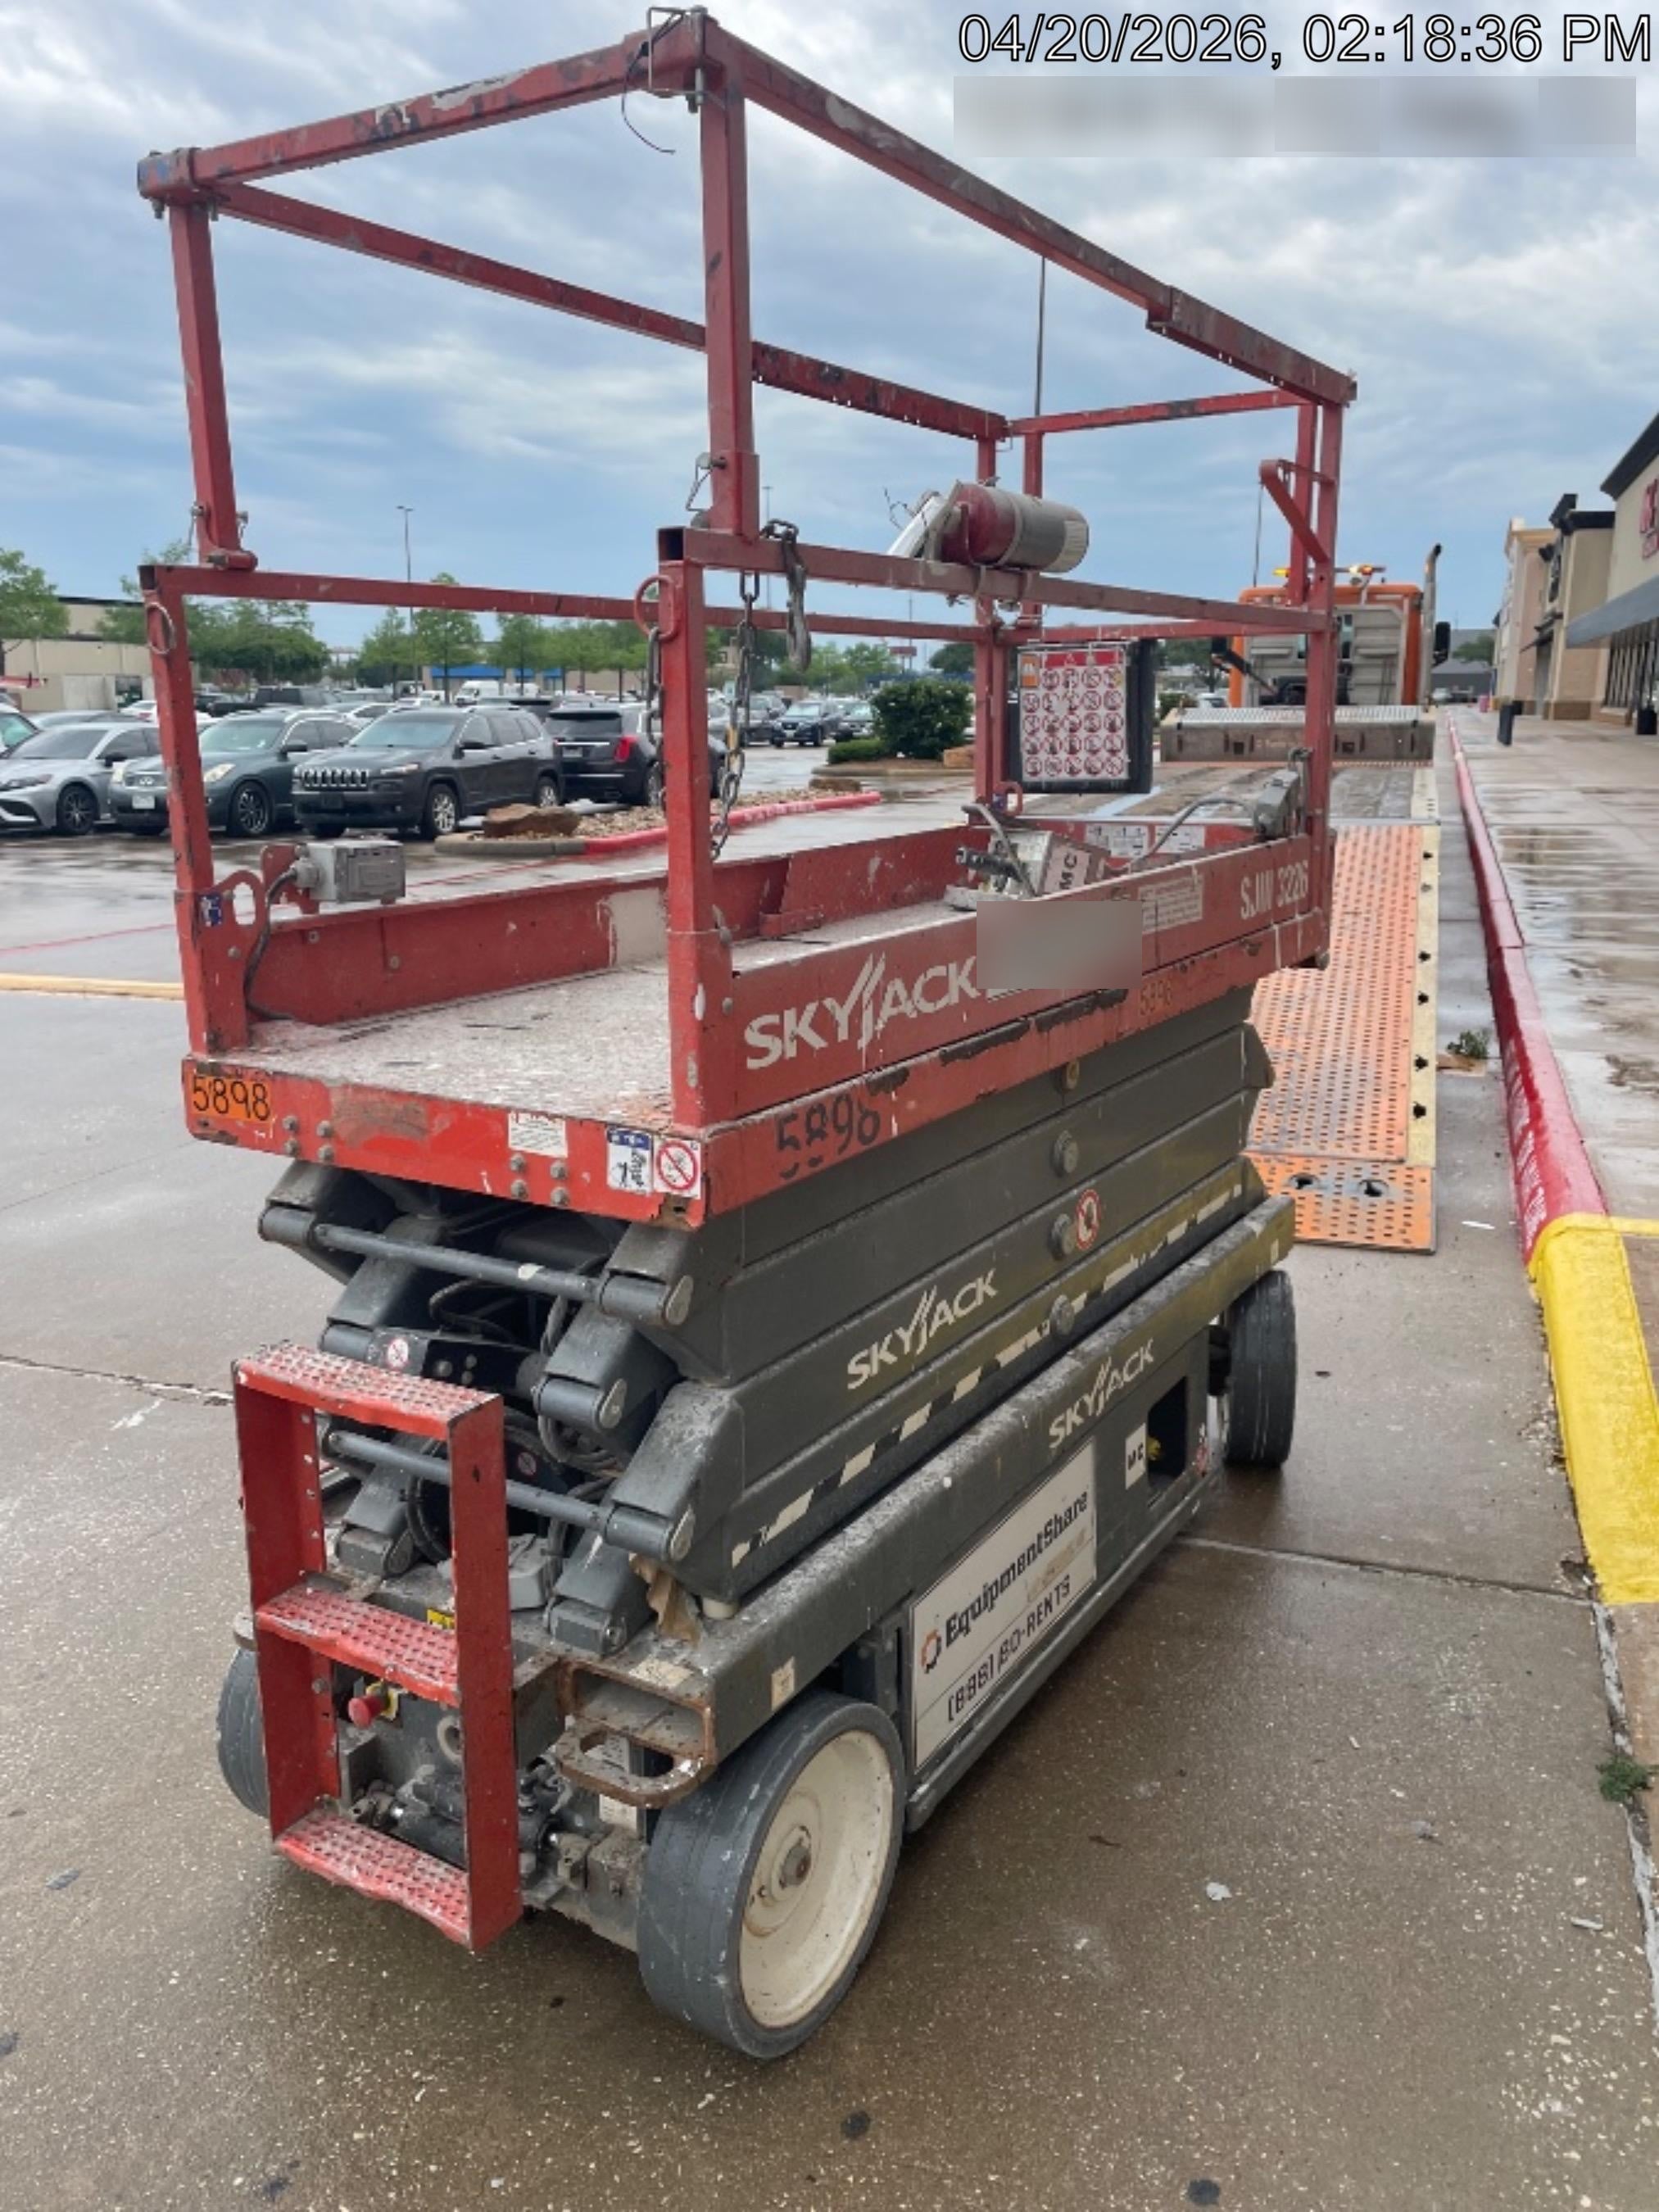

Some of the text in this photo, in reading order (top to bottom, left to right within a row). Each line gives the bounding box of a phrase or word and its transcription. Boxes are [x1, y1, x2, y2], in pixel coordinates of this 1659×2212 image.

[744, 952, 981, 1070] SKYJACK
[193, 1074, 271, 1122] 5898
[847, 1267, 999, 1390] SKYJACK
[1049, 1337, 1155, 1449] SKYJACK
[945, 1489, 1088, 1650] EquipmentShare
